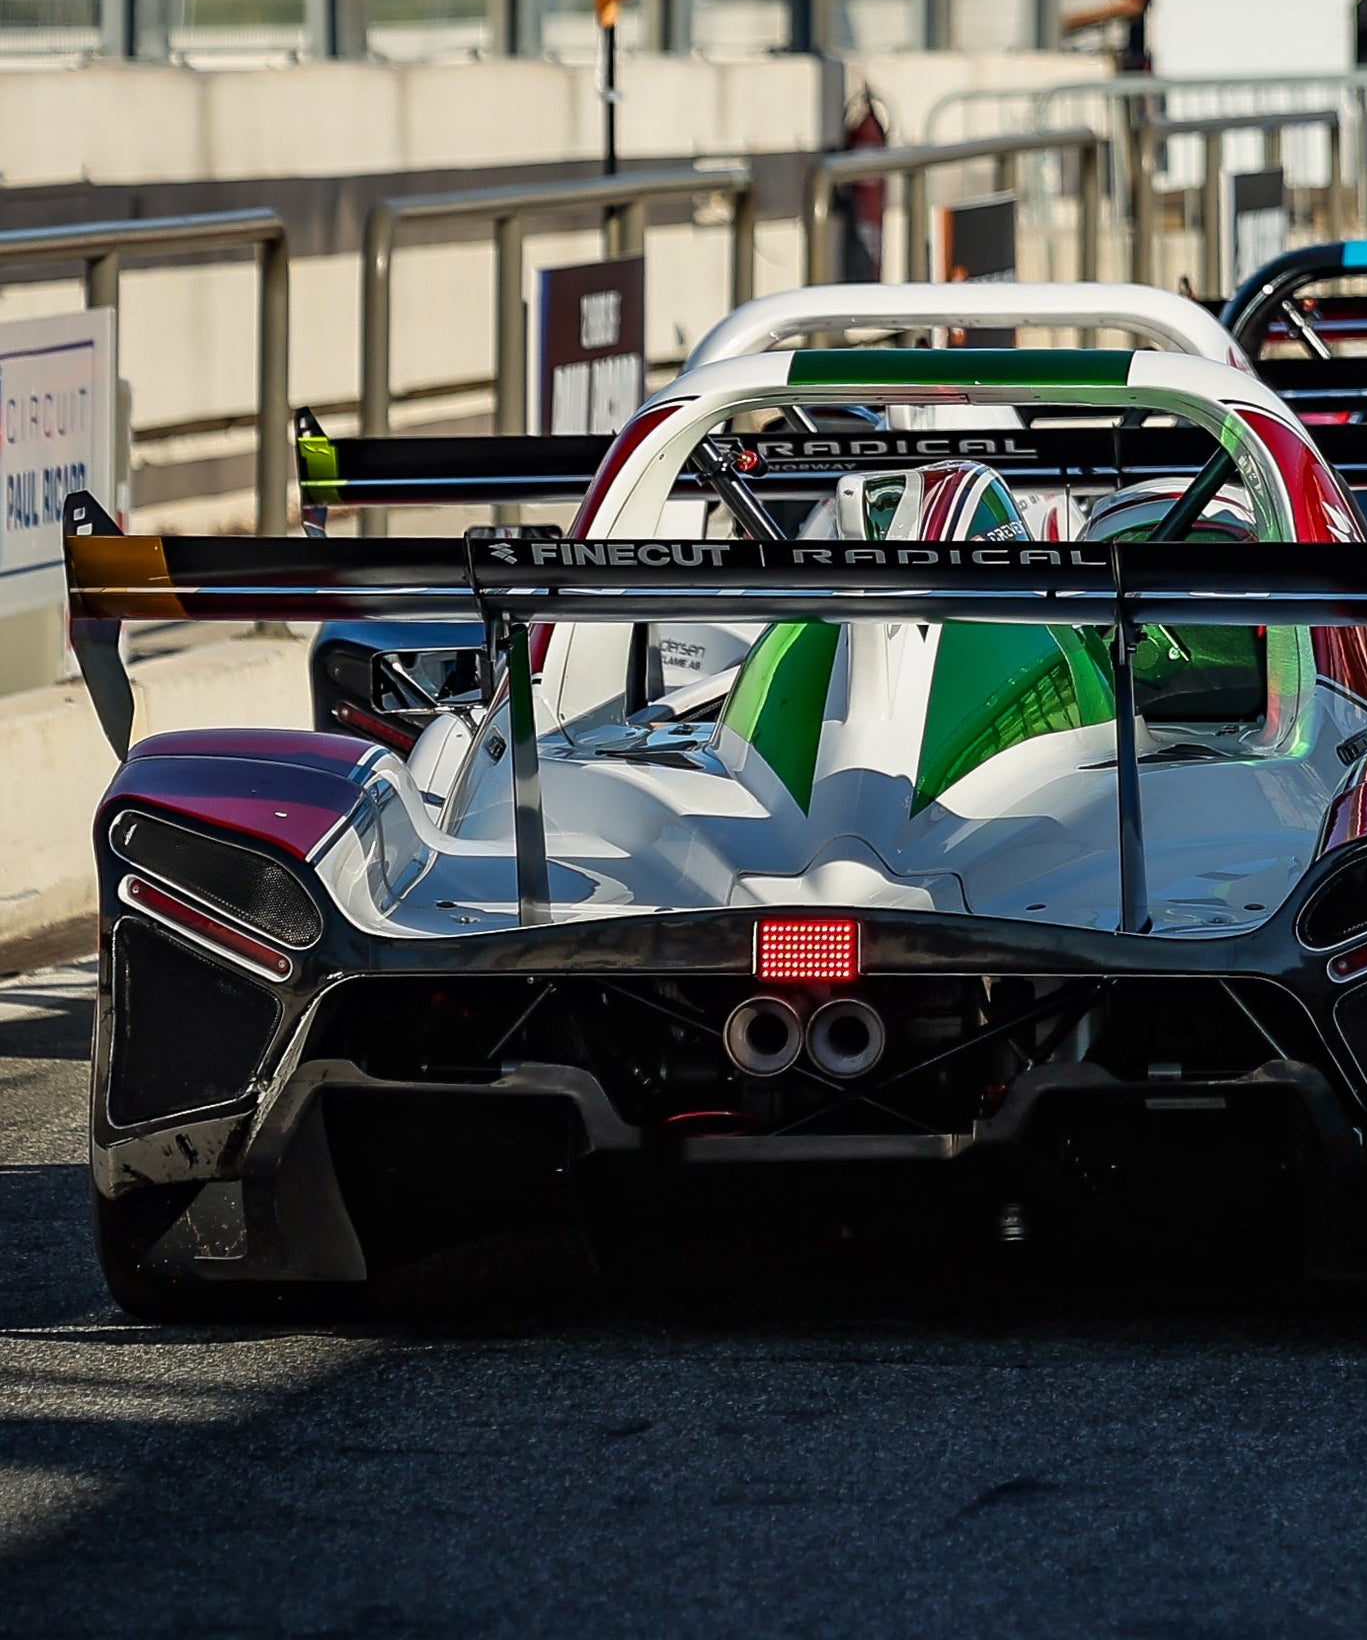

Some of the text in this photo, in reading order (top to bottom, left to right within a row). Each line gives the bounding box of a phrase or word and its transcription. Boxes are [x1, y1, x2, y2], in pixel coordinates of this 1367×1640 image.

[756, 439, 1038, 457] RADICAL
[767, 463, 858, 472] NORWAY
[6, 470, 38, 532] PAUL
[530, 543, 1108, 567] FINECUT RADICAL
[659, 638, 706, 659] dersen
